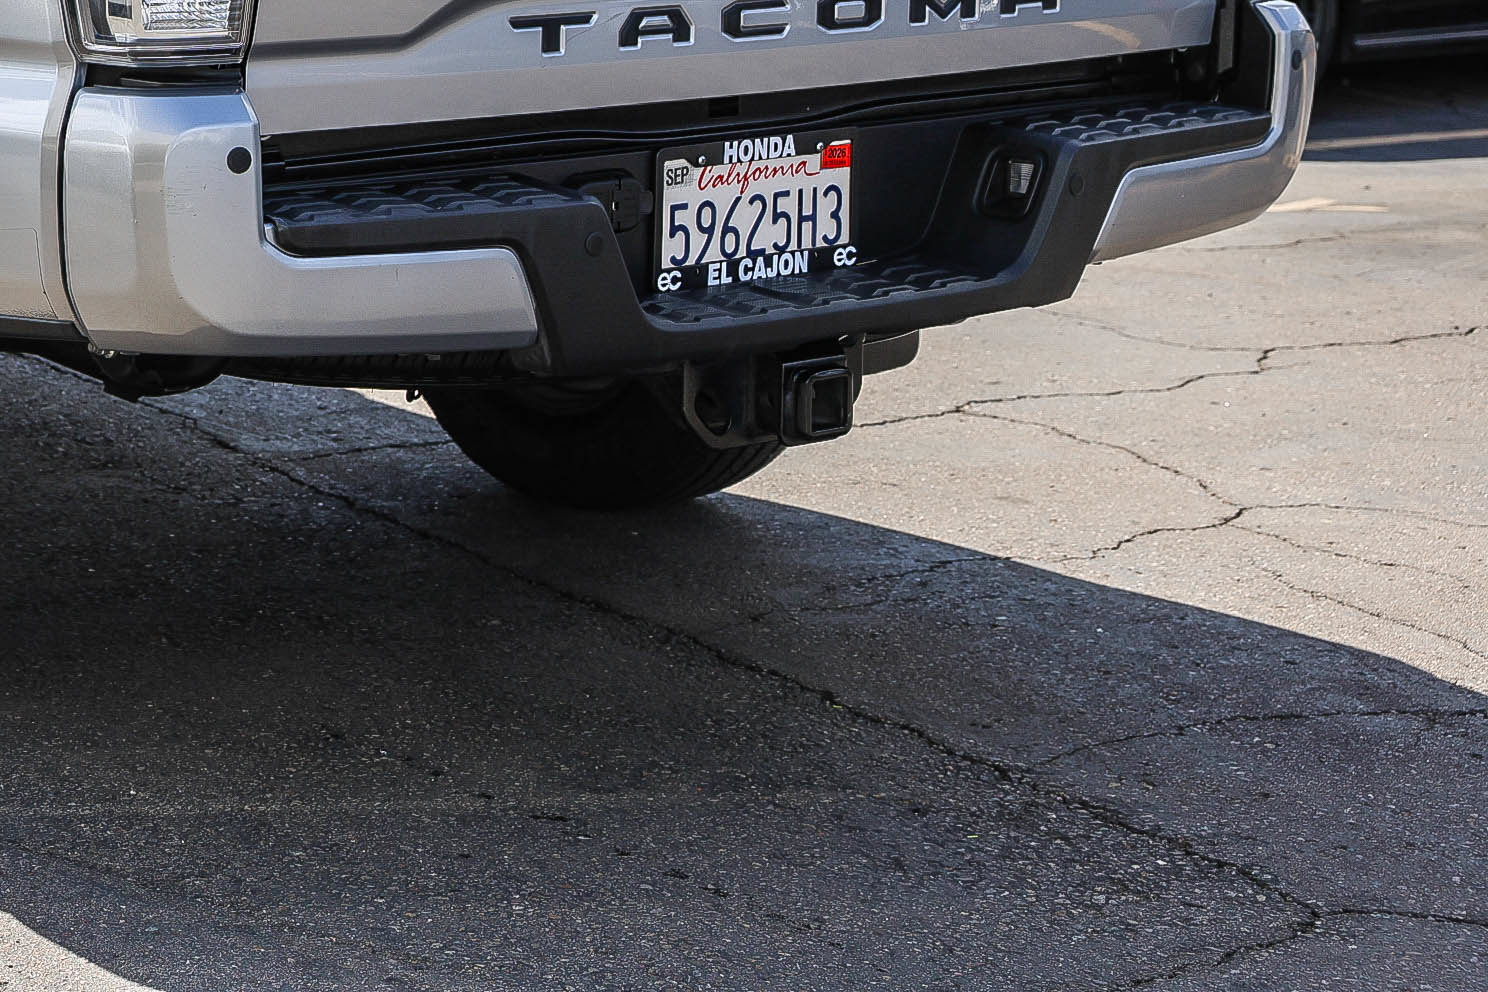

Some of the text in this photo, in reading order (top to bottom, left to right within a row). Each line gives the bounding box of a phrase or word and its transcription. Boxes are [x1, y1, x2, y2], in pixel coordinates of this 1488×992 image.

[723, 134, 796, 164] HONDA
[827, 147, 847, 159] 2026
[666, 166, 690, 186] SEP
[698, 159, 821, 196] California
[669, 183, 844, 267] 59625H3
[708, 251, 809, 287] EL CAJON
